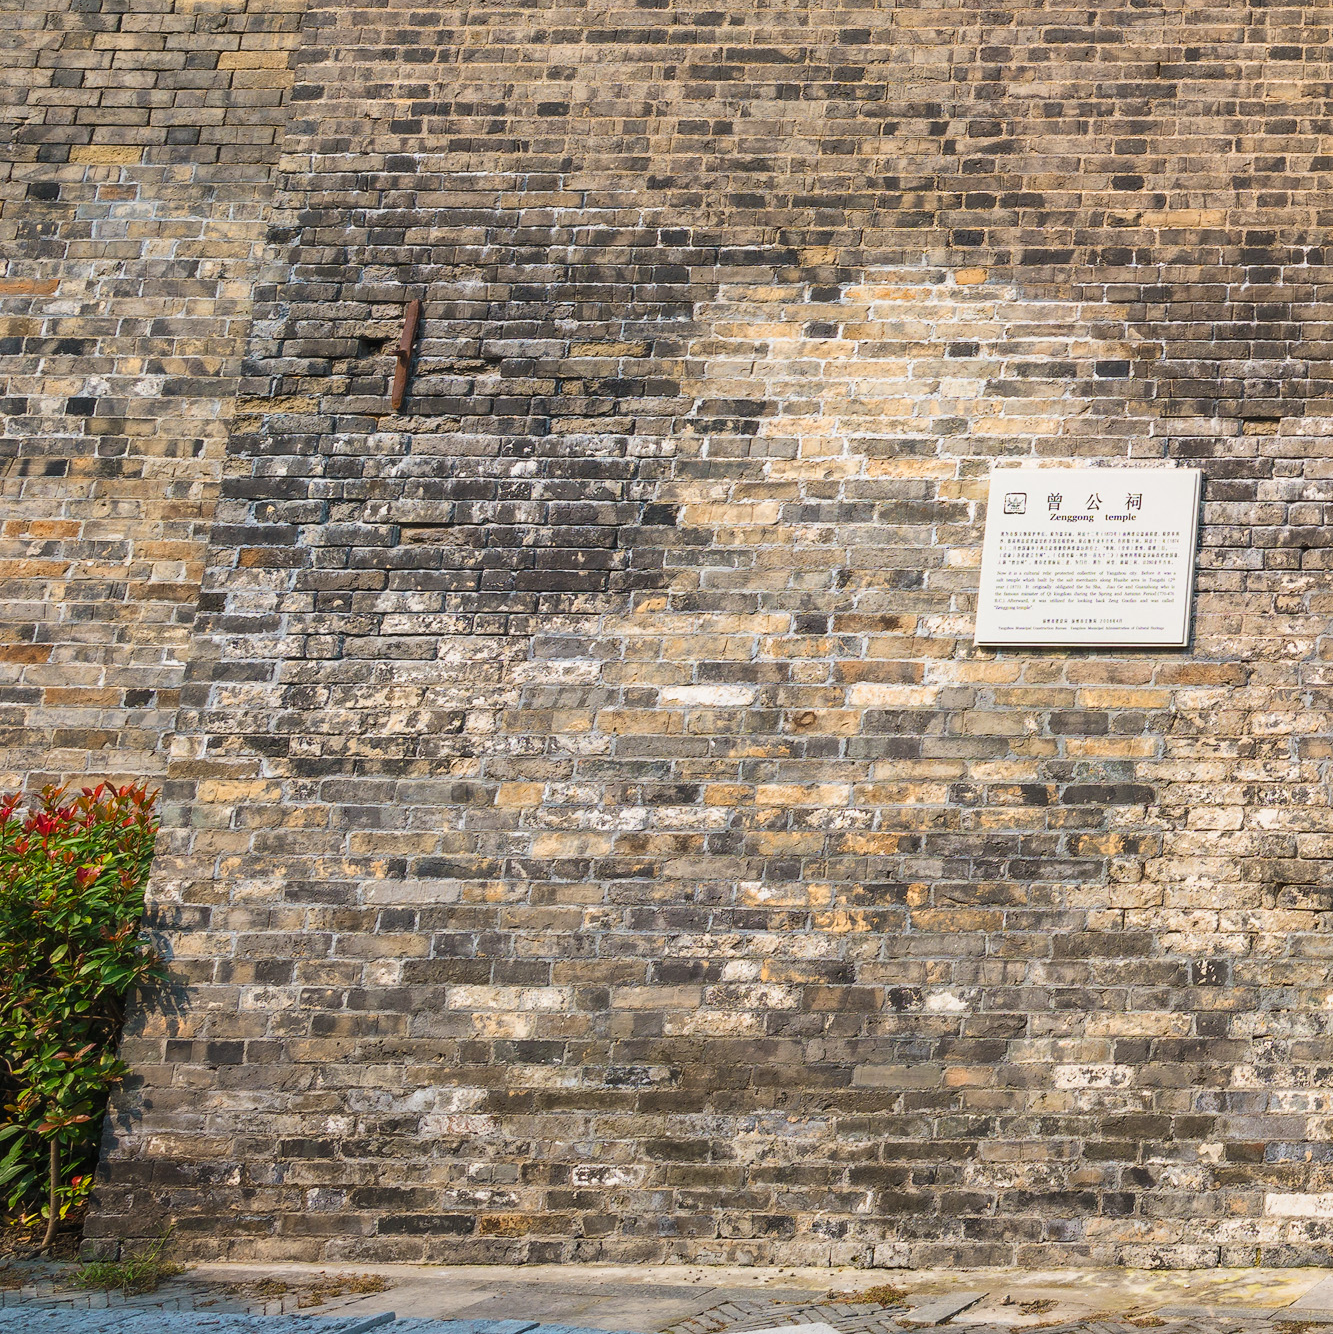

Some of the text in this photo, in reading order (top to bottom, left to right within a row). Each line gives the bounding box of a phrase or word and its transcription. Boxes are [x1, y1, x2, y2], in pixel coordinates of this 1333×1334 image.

[1047, 493, 1142, 511] 曾公祠
[1050, 513, 1136, 522] Zenggong temple
